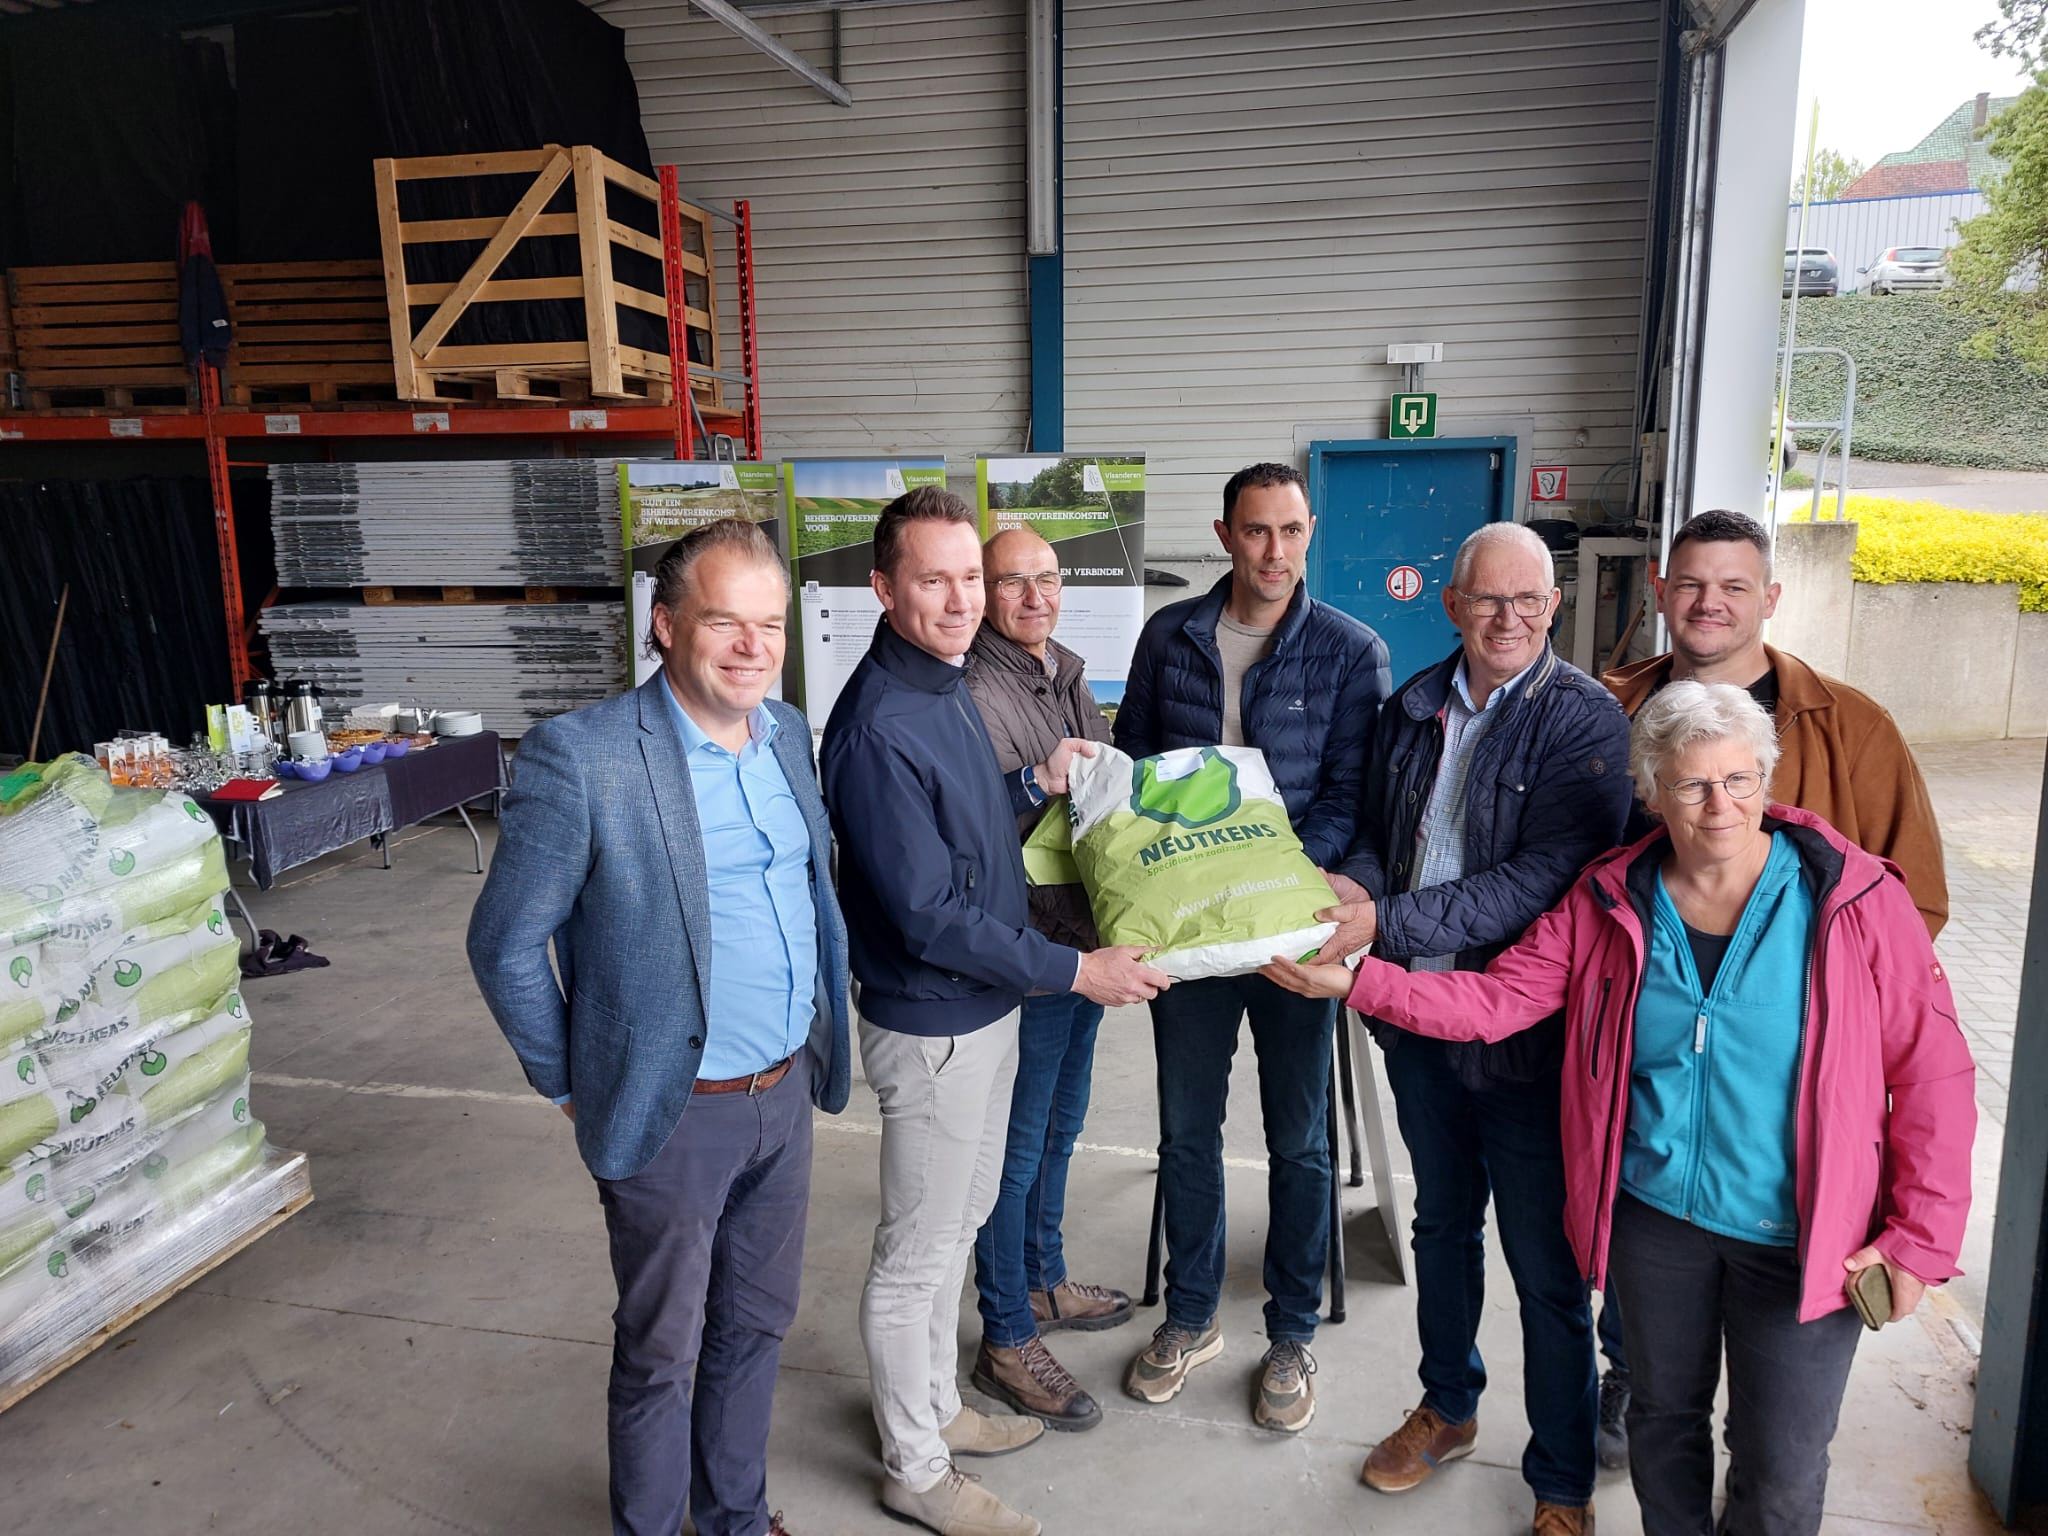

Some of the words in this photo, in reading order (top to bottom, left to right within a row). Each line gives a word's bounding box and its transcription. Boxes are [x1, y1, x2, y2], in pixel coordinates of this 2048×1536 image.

[1105, 471, 1142, 479] Vlaanderen
[640, 498, 662, 507] SLUIT
[665, 498, 681, 507] EEN
[641, 508, 736, 517] BEHEEROVEREENKOMST
[997, 511, 1109, 520] BEHEEROVEREENKOMSTEN
[641, 517, 652, 525] EN
[655, 517, 680, 526] WERK
[997, 522, 1022, 530] VOOR
[805, 524, 830, 532] VOOR
[1074, 567, 1124, 576] VERBINDEN
[1139, 823, 1278, 866] NEUTKENS
[1172, 872, 1300, 920] www.neutkens.nl
